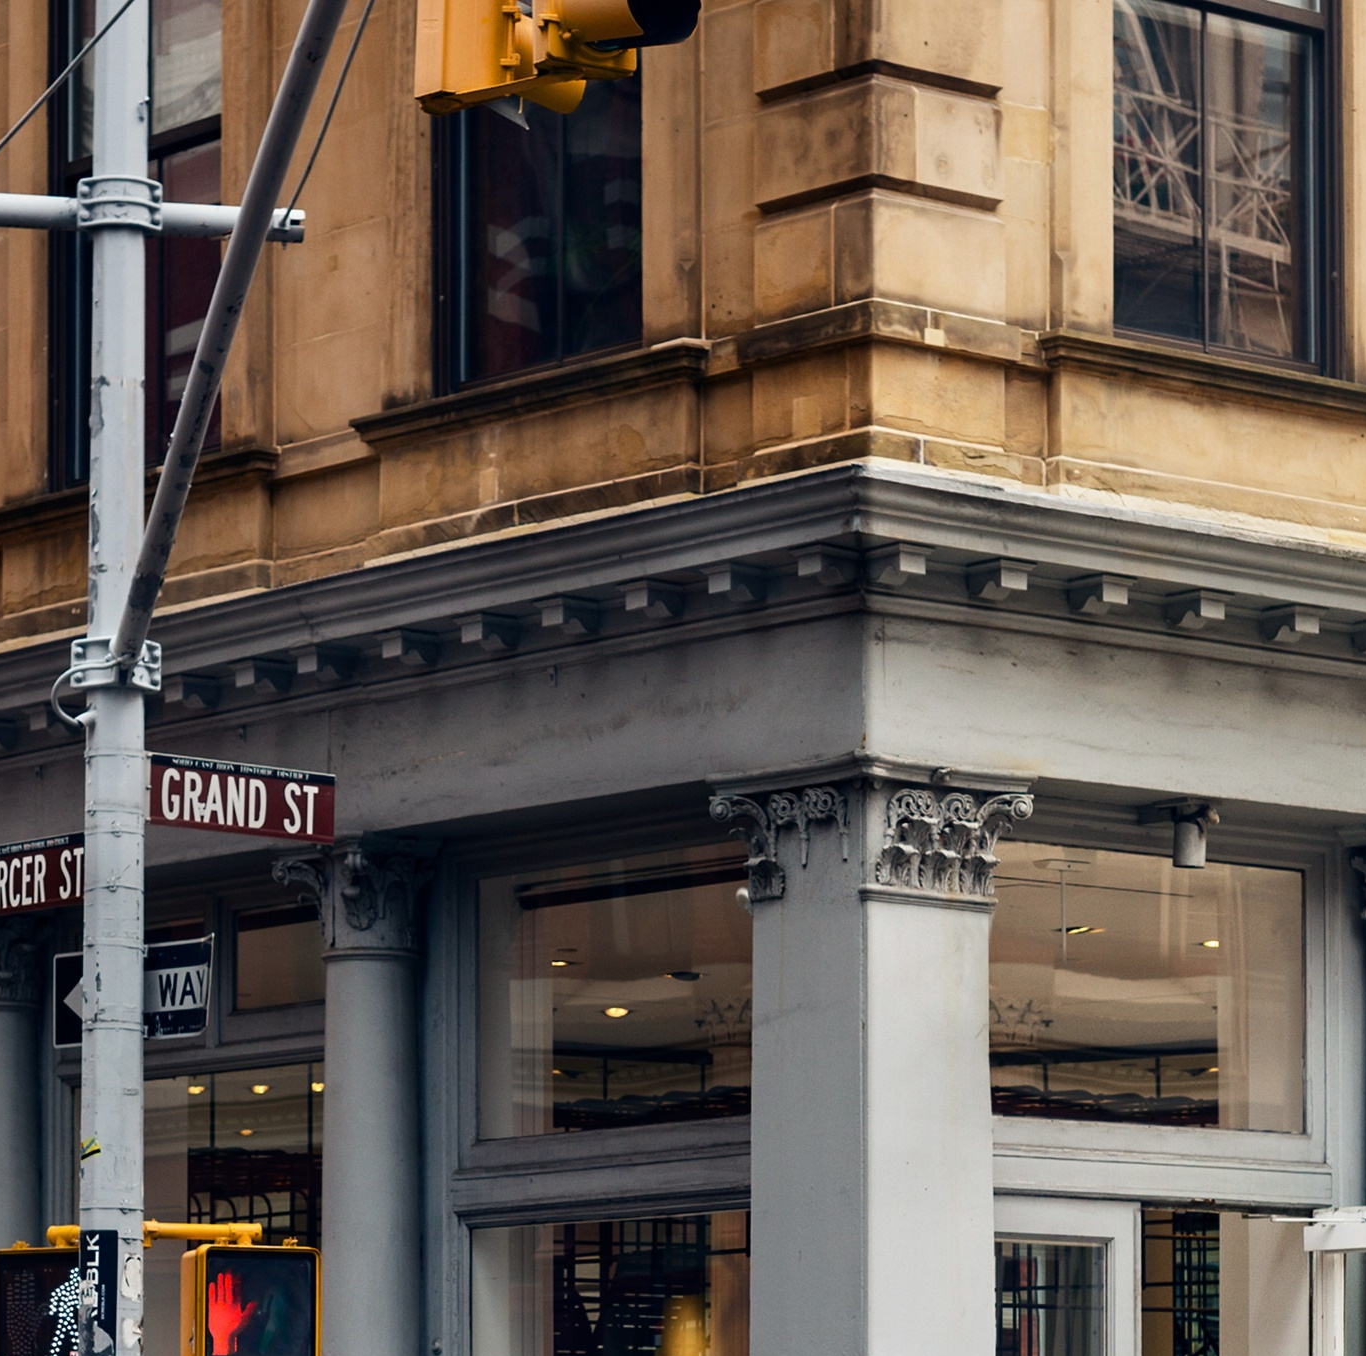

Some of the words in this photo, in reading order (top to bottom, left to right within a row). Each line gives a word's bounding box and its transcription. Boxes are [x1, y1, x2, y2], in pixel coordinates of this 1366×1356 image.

[161, 767, 267, 829] GRAND
[283, 782, 319, 835] ST
[58, 847, 84, 900] ST
[158, 968, 206, 1007] WAY
